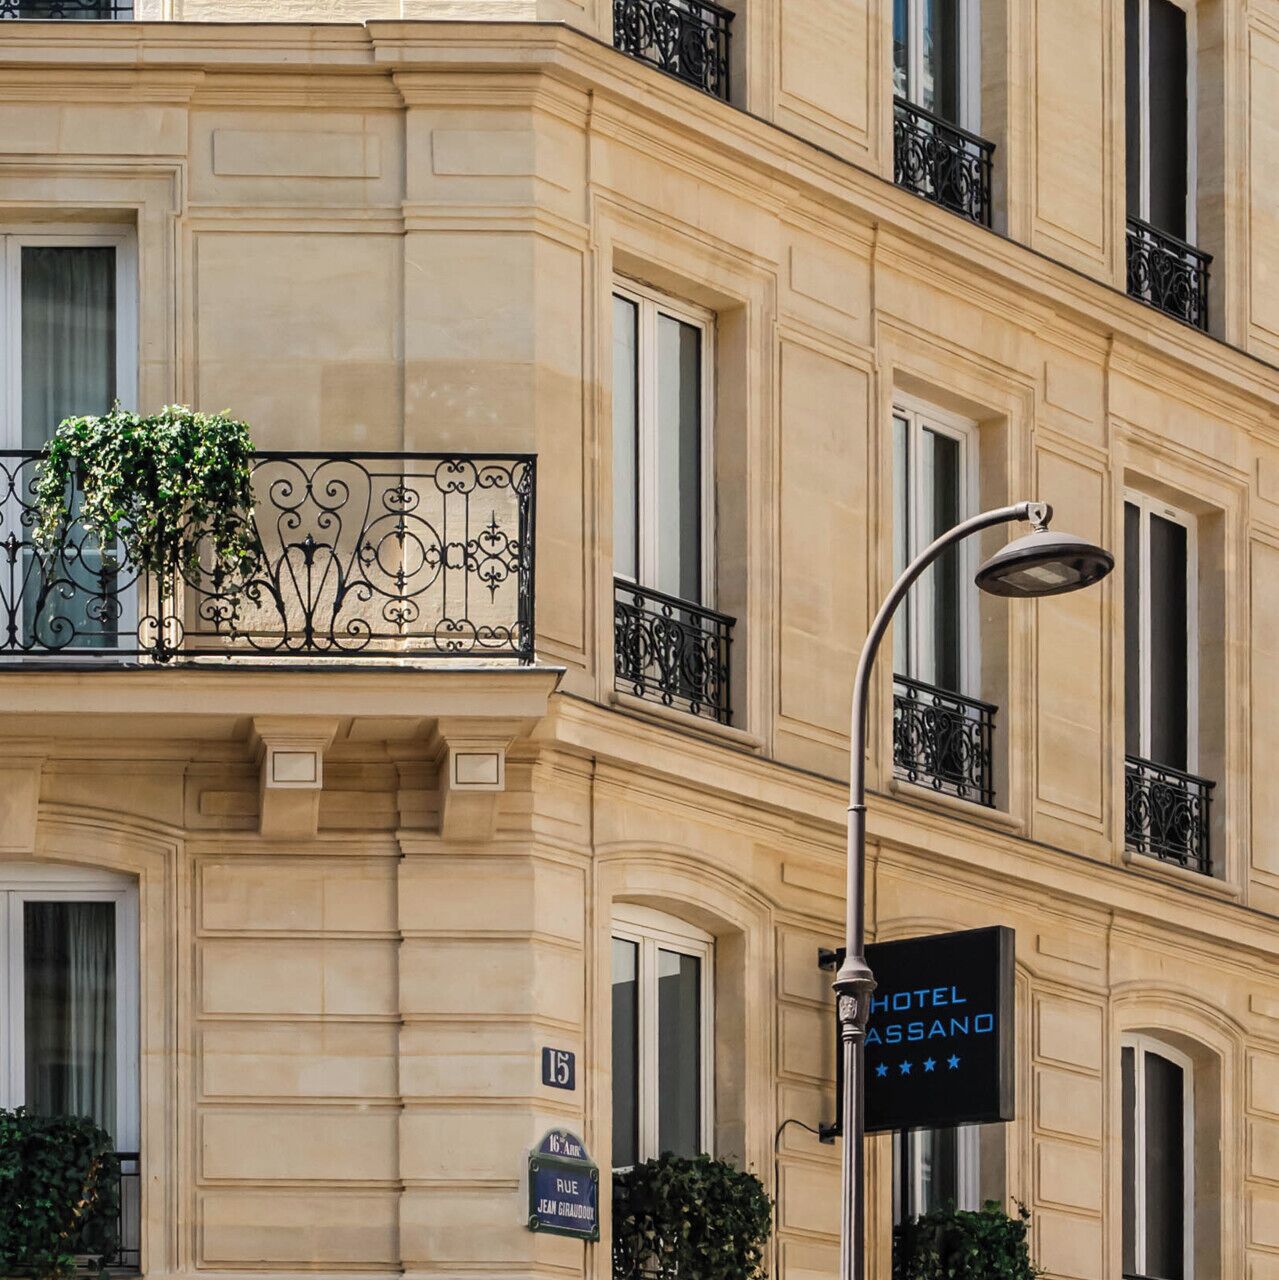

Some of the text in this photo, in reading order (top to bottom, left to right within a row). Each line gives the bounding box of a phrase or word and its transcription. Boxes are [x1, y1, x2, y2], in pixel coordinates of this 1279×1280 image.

[870, 986, 967, 1014] HOTEL
[864, 1013, 994, 1047] ASSANO
[549, 1050, 570, 1085] 15
[556, 1178, 579, 1195] RUE
[537, 1198, 594, 1221] JEAN GIRAUDOUX
